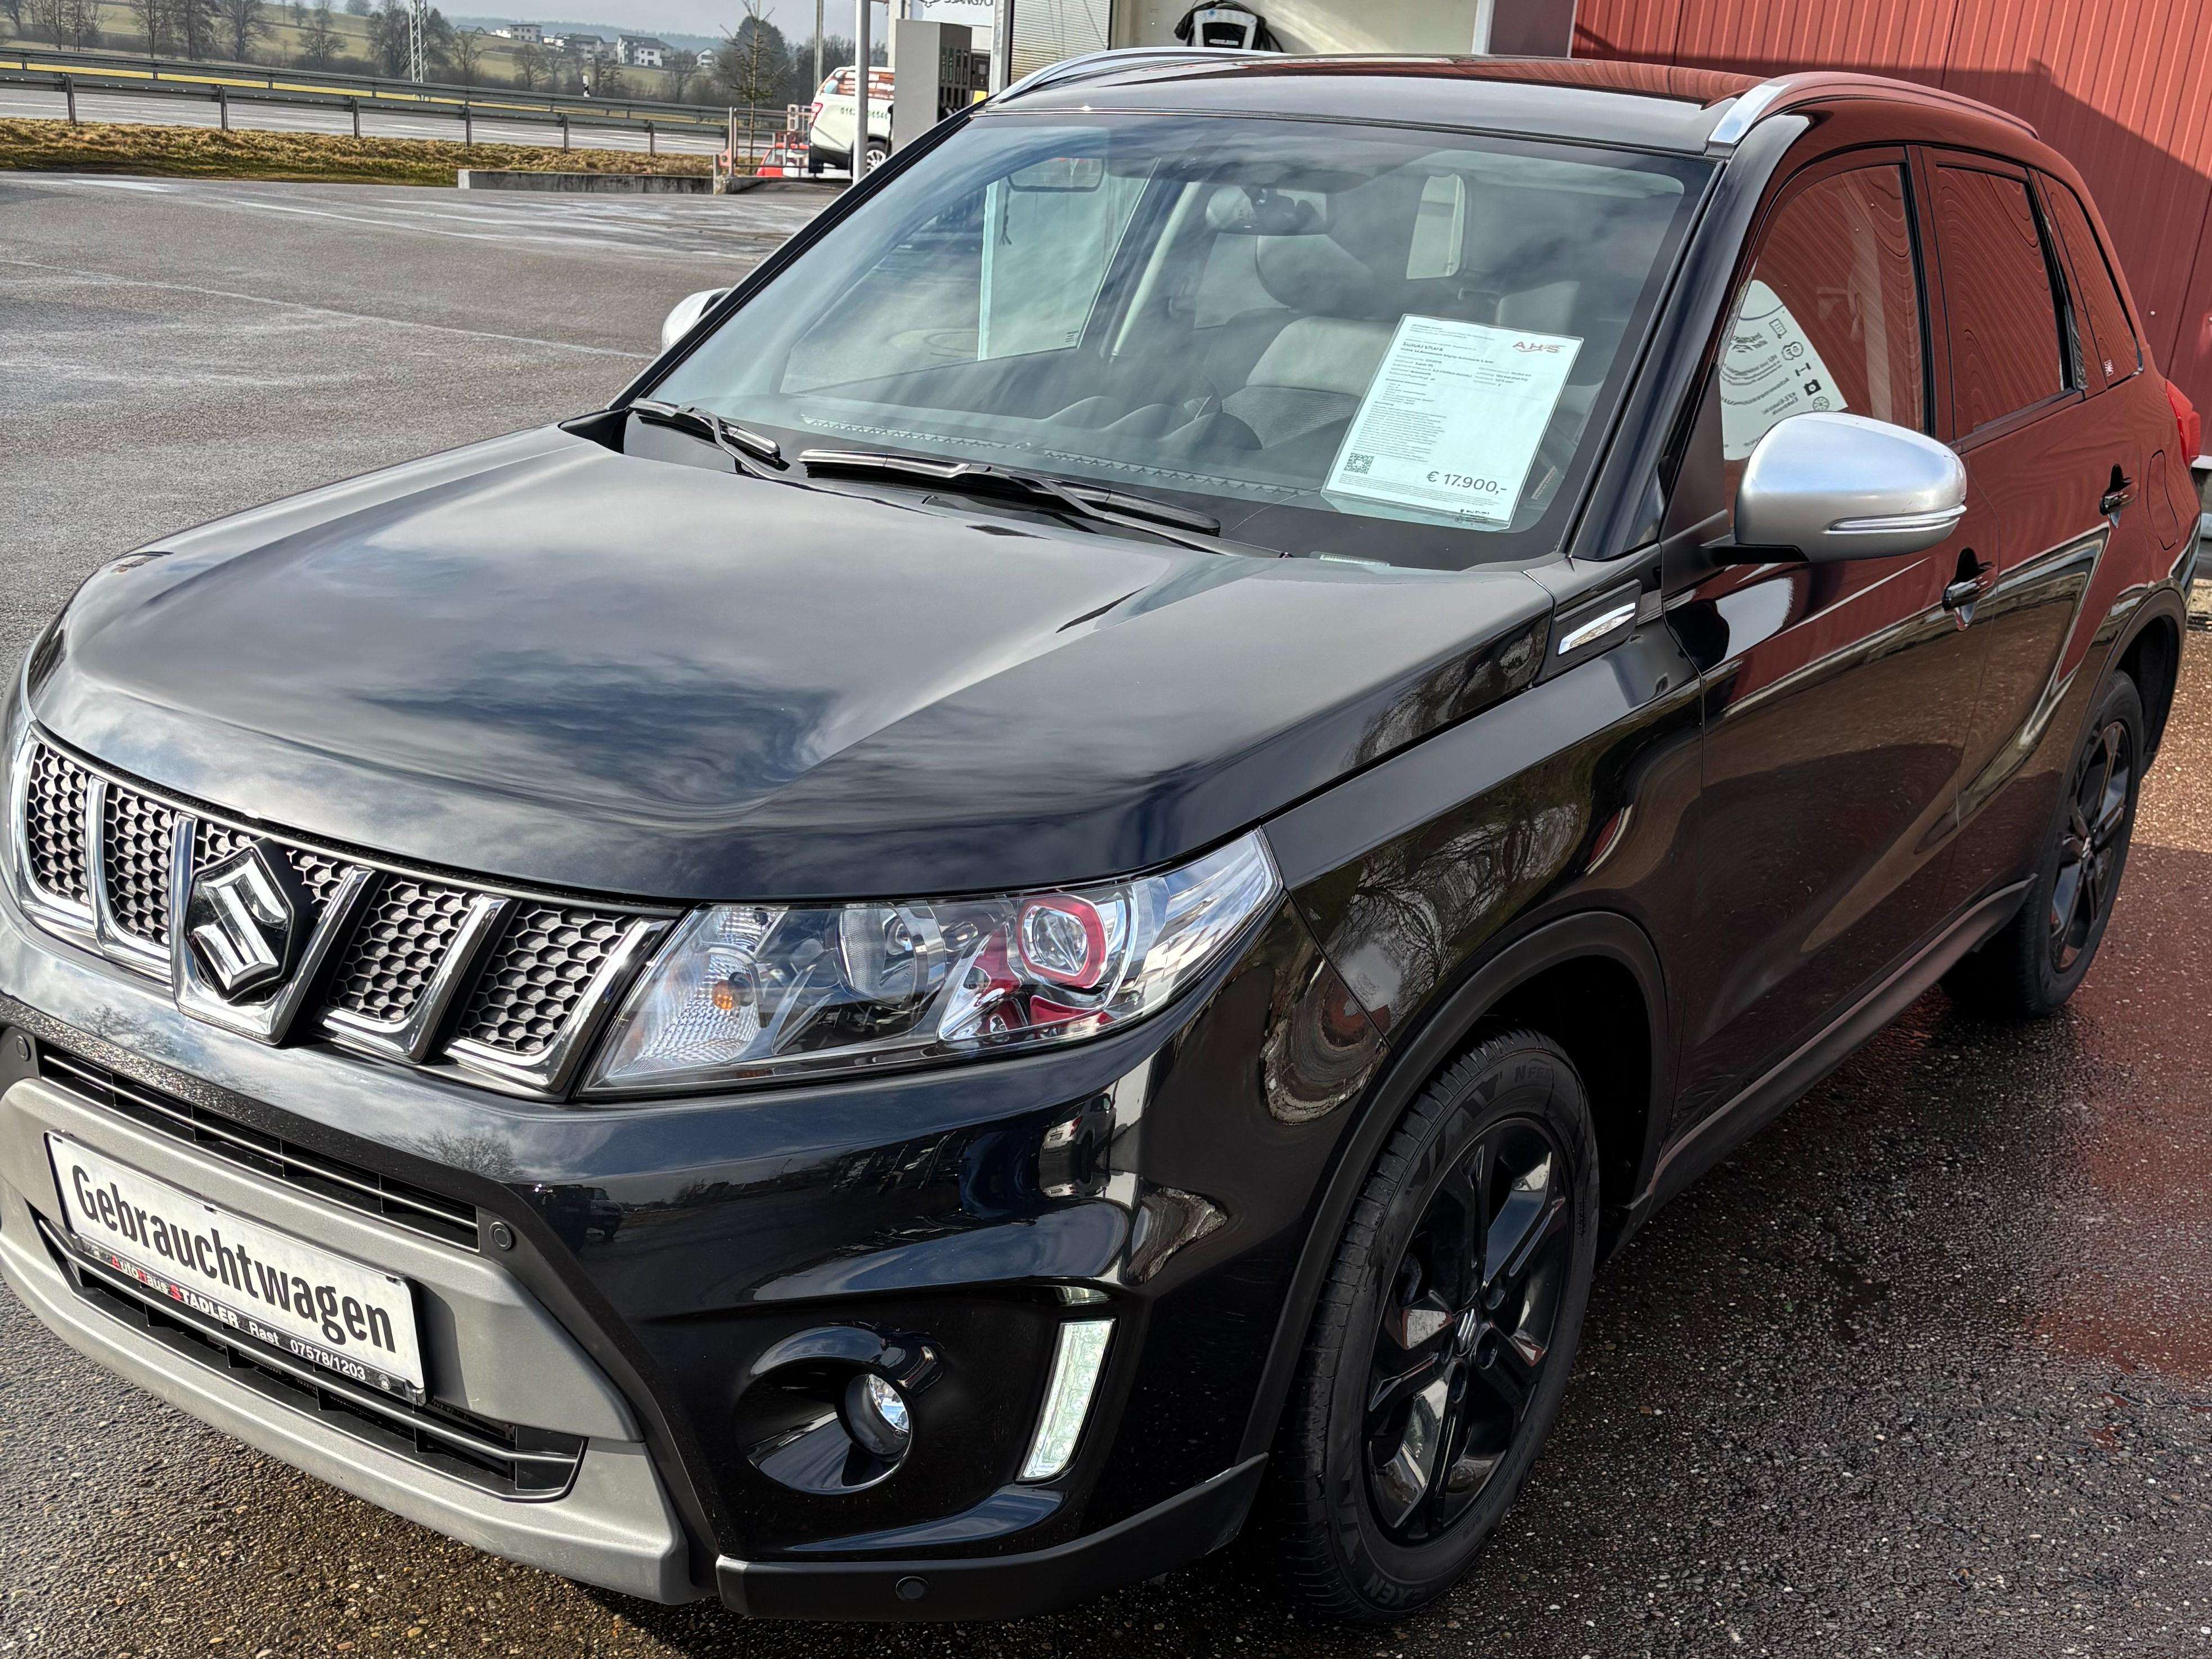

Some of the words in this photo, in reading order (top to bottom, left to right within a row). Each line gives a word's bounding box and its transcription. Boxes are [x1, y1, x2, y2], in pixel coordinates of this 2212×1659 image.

[1426, 471, 1439, 482] €
[1444, 474, 1507, 495] 17.900,-
[72, 1165, 396, 1354] Gebrauchtwagen
[169, 1284, 240, 1328] STADLER
[249, 1320, 281, 1346] Rast
[290, 1339, 366, 1381] 07578/1203
